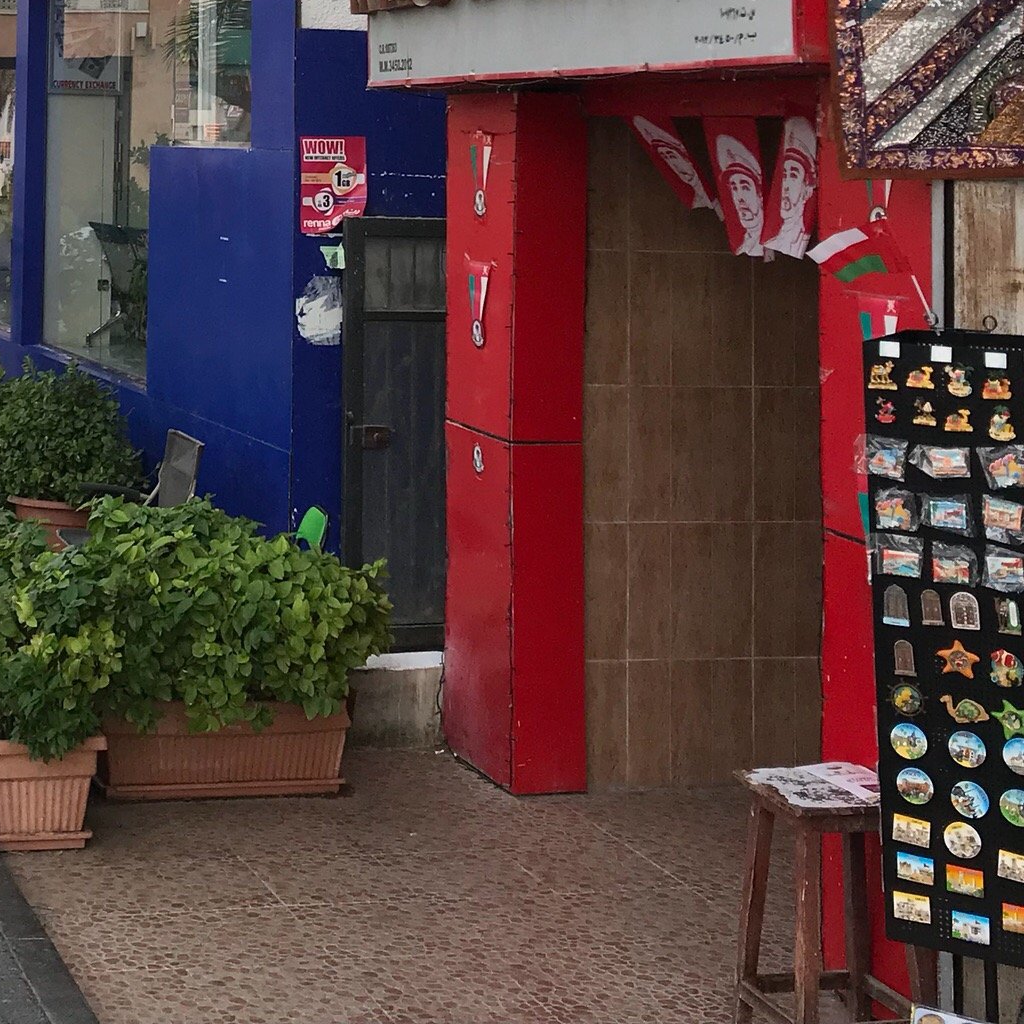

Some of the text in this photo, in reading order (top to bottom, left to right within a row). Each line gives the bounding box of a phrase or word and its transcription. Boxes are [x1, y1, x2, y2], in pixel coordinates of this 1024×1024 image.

[53, 79, 117, 90] CURRENCY EXCHANGE
[303, 140, 345, 155] WOW!
[334, 170, 342, 187] 1
[322, 194, 331, 208] 3
[303, 219, 332, 228] renna
